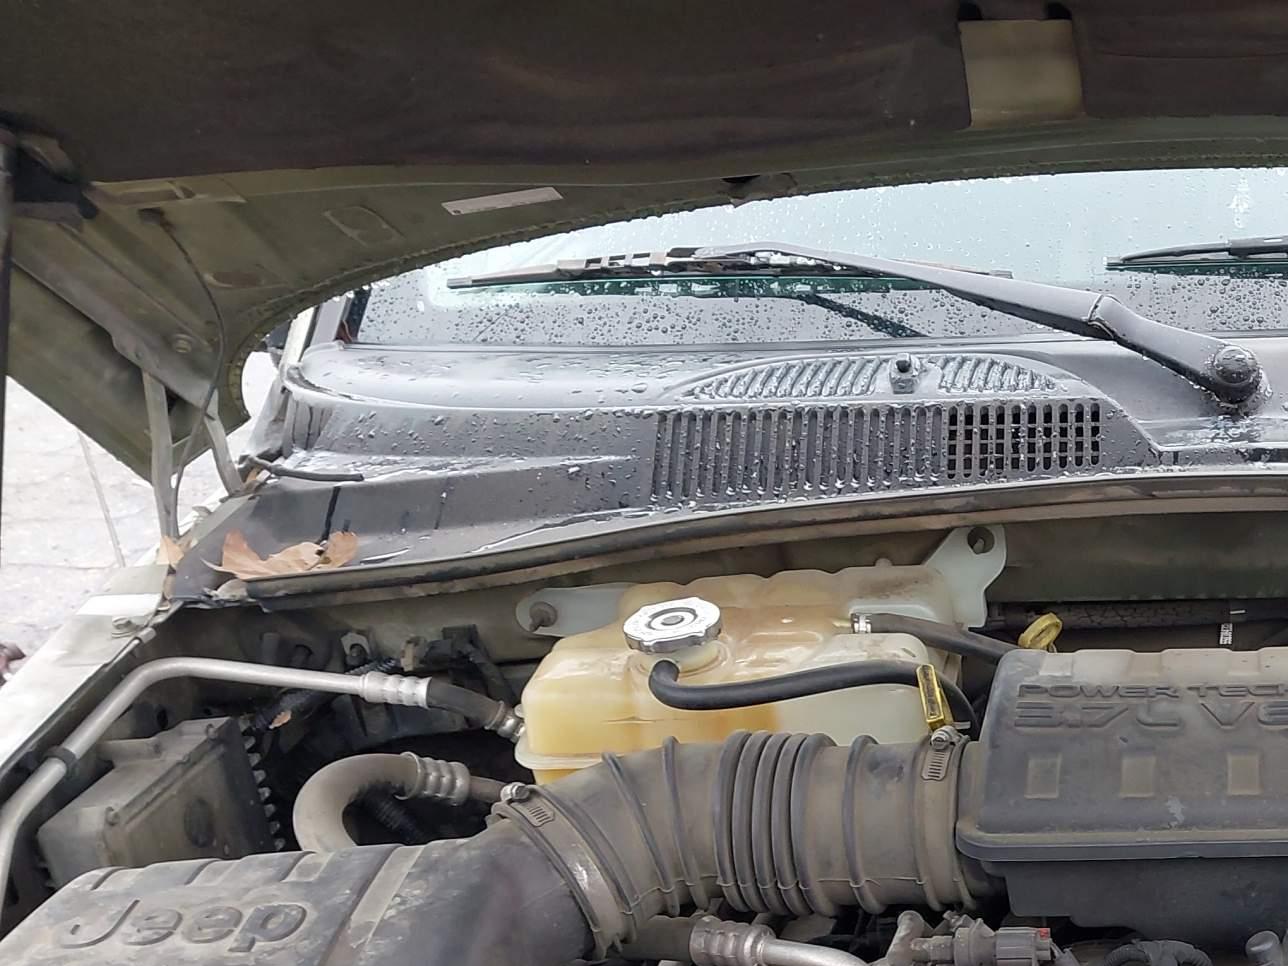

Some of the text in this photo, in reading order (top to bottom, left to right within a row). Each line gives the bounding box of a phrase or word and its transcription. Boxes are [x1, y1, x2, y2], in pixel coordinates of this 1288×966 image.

[1018, 684, 1179, 700] POWER
[1013, 701, 1182, 730] 3.7L
[59, 899, 308, 953] Jeep
